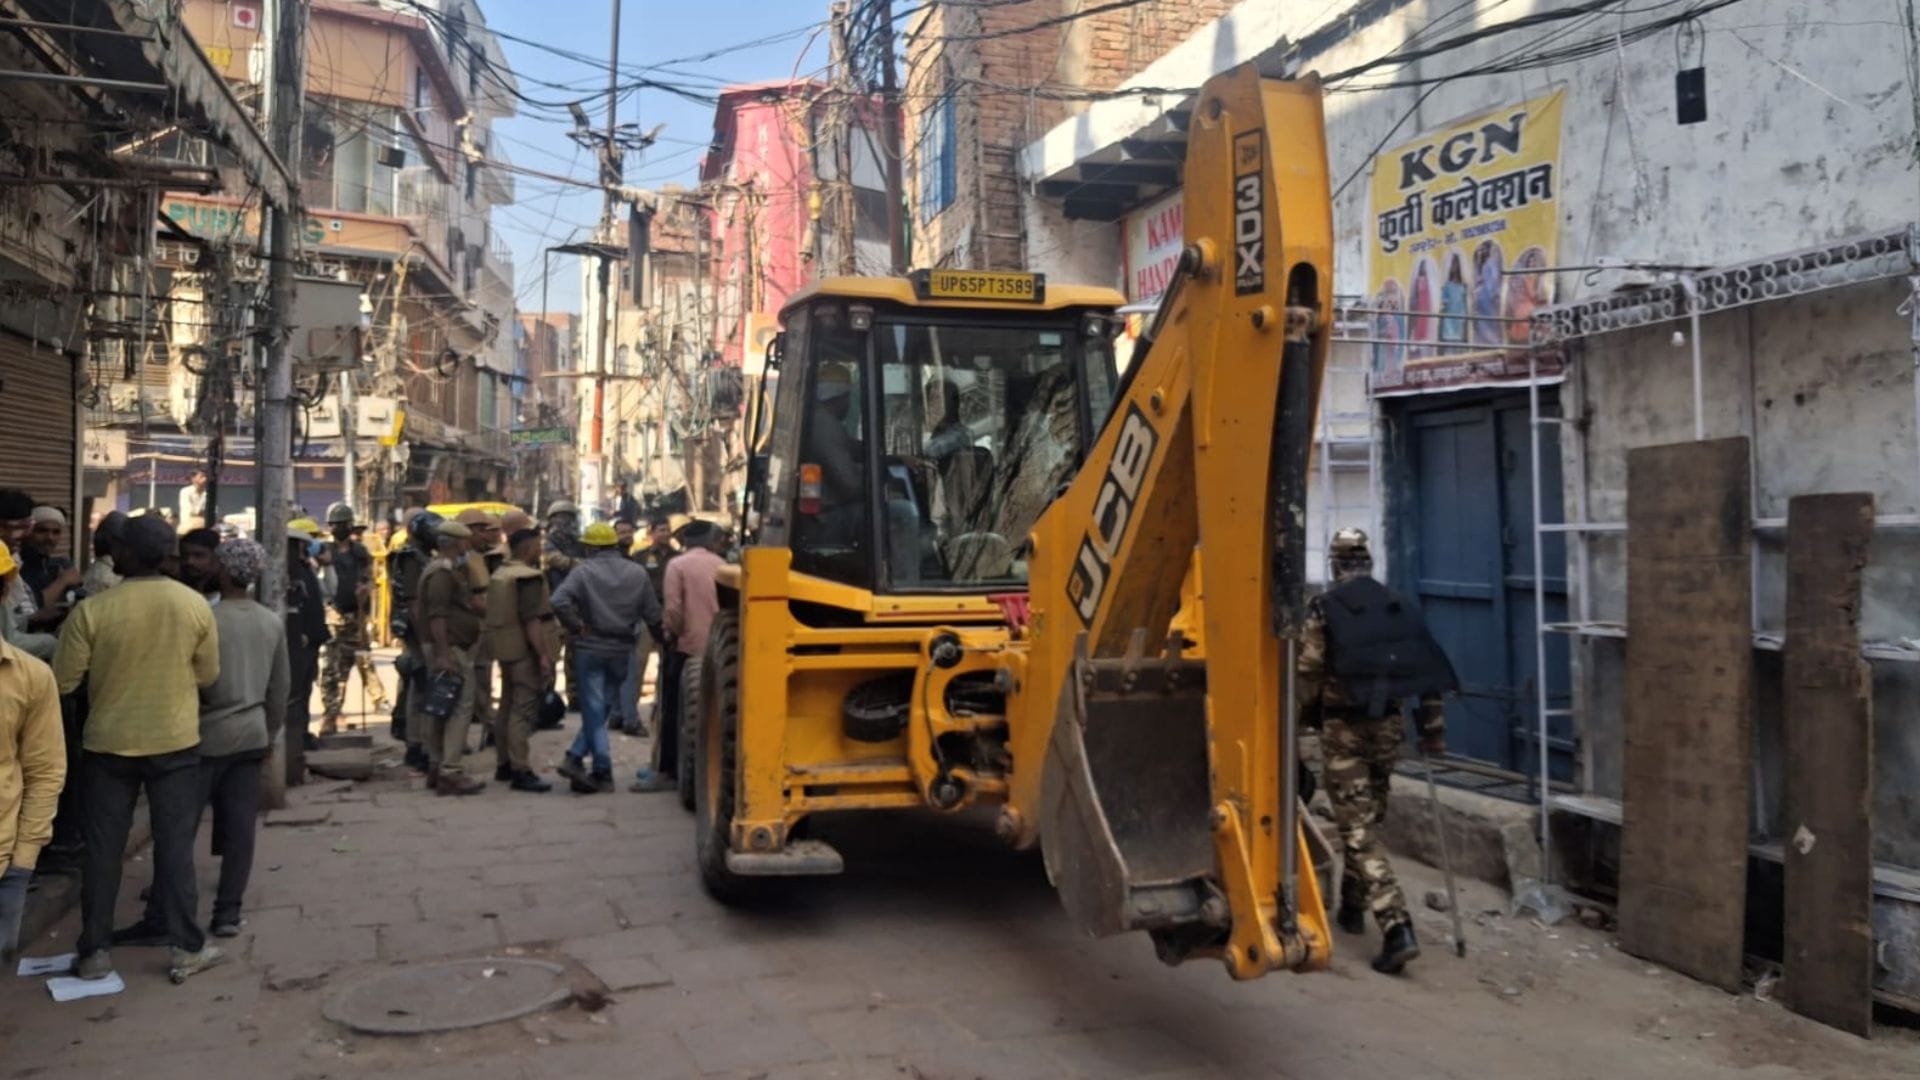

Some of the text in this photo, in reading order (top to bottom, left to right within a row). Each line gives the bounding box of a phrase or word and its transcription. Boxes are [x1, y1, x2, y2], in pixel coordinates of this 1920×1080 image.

[1399, 112, 1527, 190] KGN
[1236, 176, 1262, 277] 3DX
[1379, 163, 1553, 253] कुर्ती कलेक्शन
[1079, 412, 1153, 620] JCB
